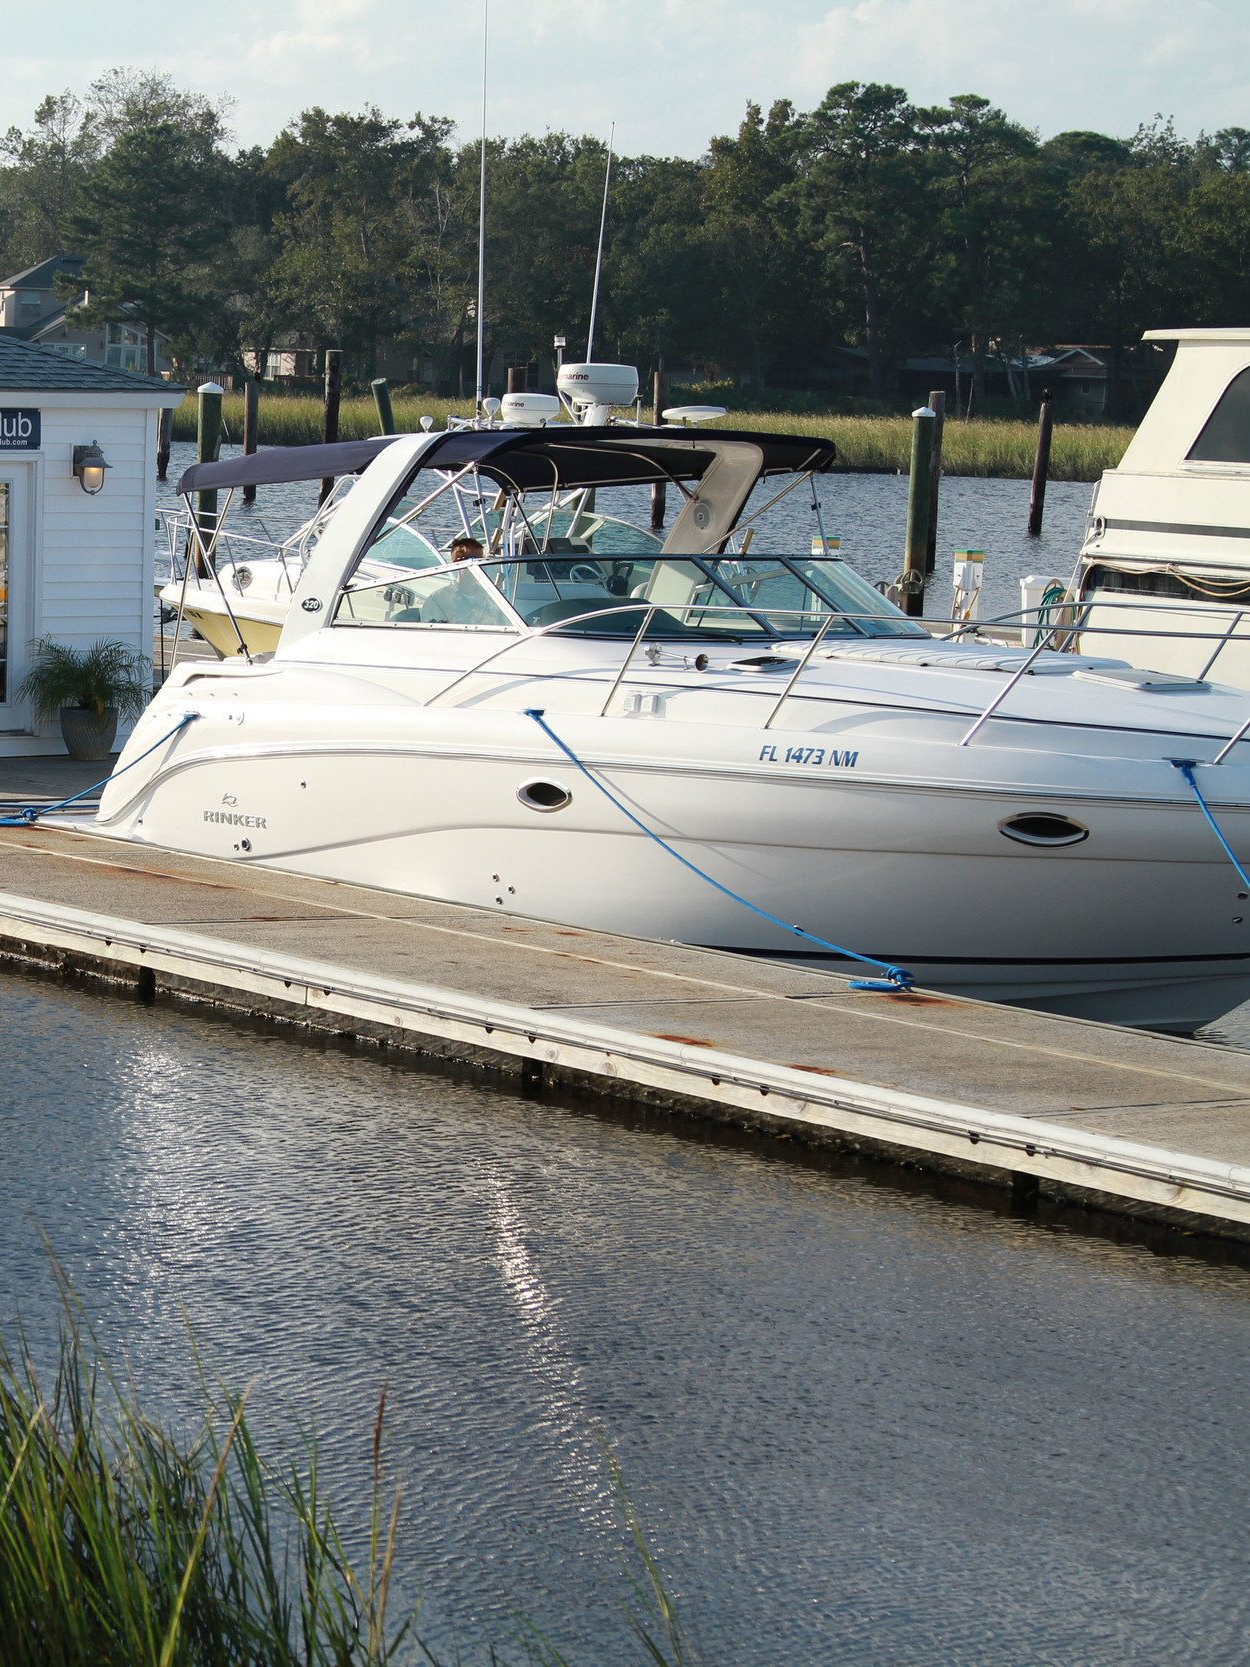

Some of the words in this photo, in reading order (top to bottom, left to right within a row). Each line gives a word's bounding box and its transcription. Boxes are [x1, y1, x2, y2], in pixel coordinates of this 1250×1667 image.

[304, 600, 319, 609] 320
[759, 745, 778, 762] FL
[785, 747, 825, 765] 1473
[828, 750, 859, 768] NM
[203, 810, 267, 829] RINKER
